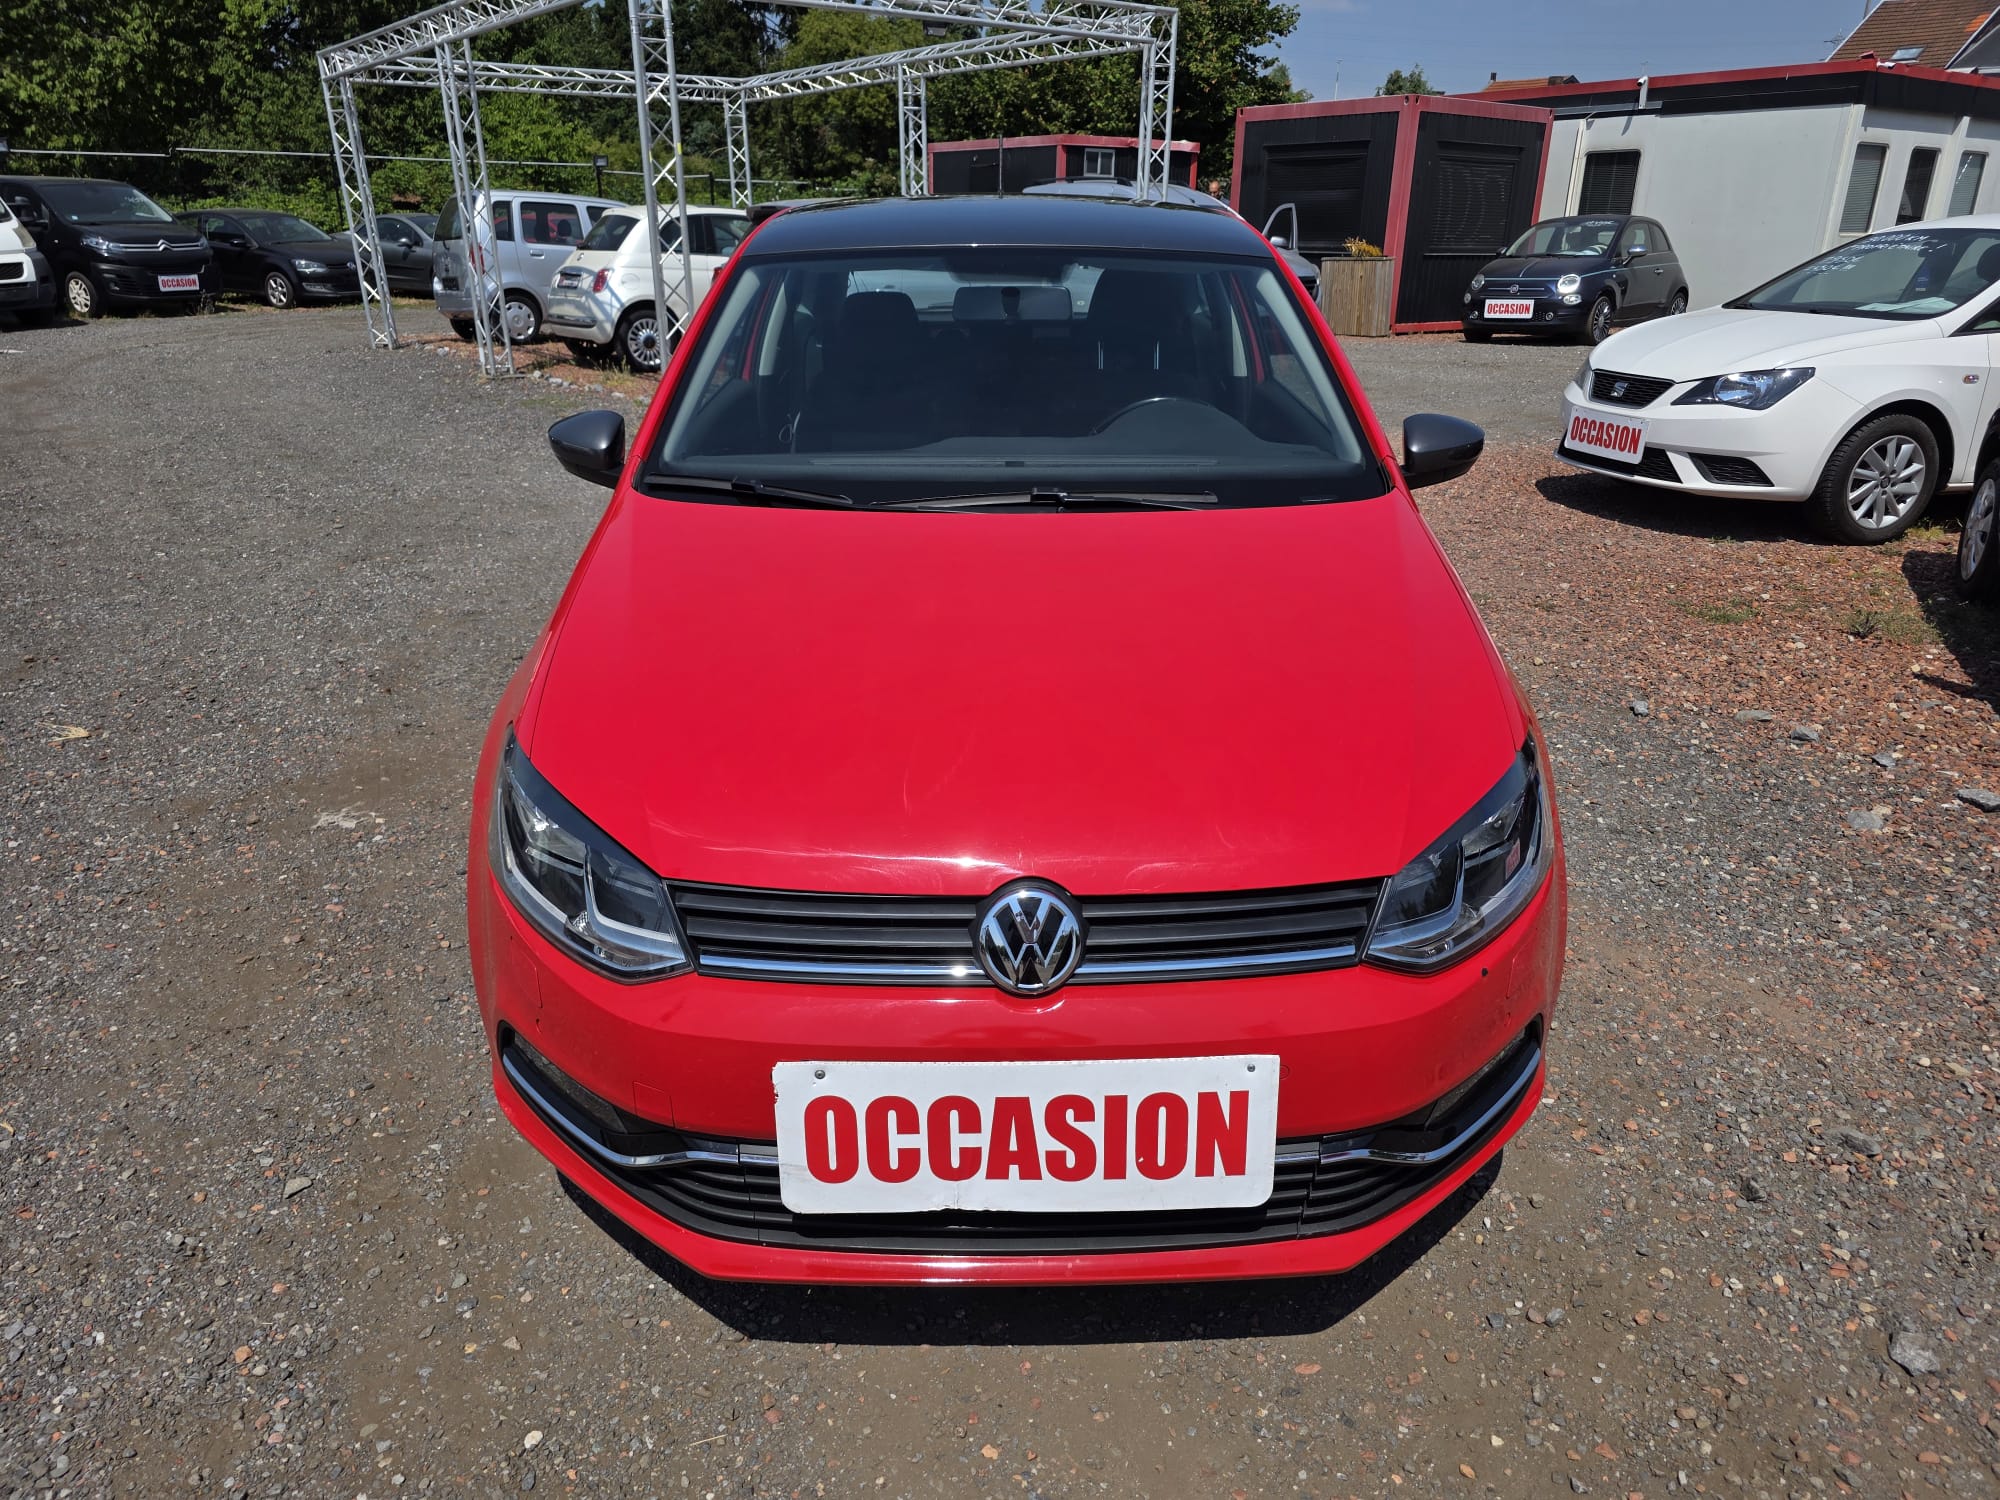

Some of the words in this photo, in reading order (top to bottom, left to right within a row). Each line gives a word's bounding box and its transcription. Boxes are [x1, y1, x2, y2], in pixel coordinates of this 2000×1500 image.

[161, 278, 197, 288] OCCASION
[1487, 303, 1531, 315] OCCASION
[1570, 415, 1642, 455] OCCASION
[804, 1090, 1249, 1184] OCCASION
